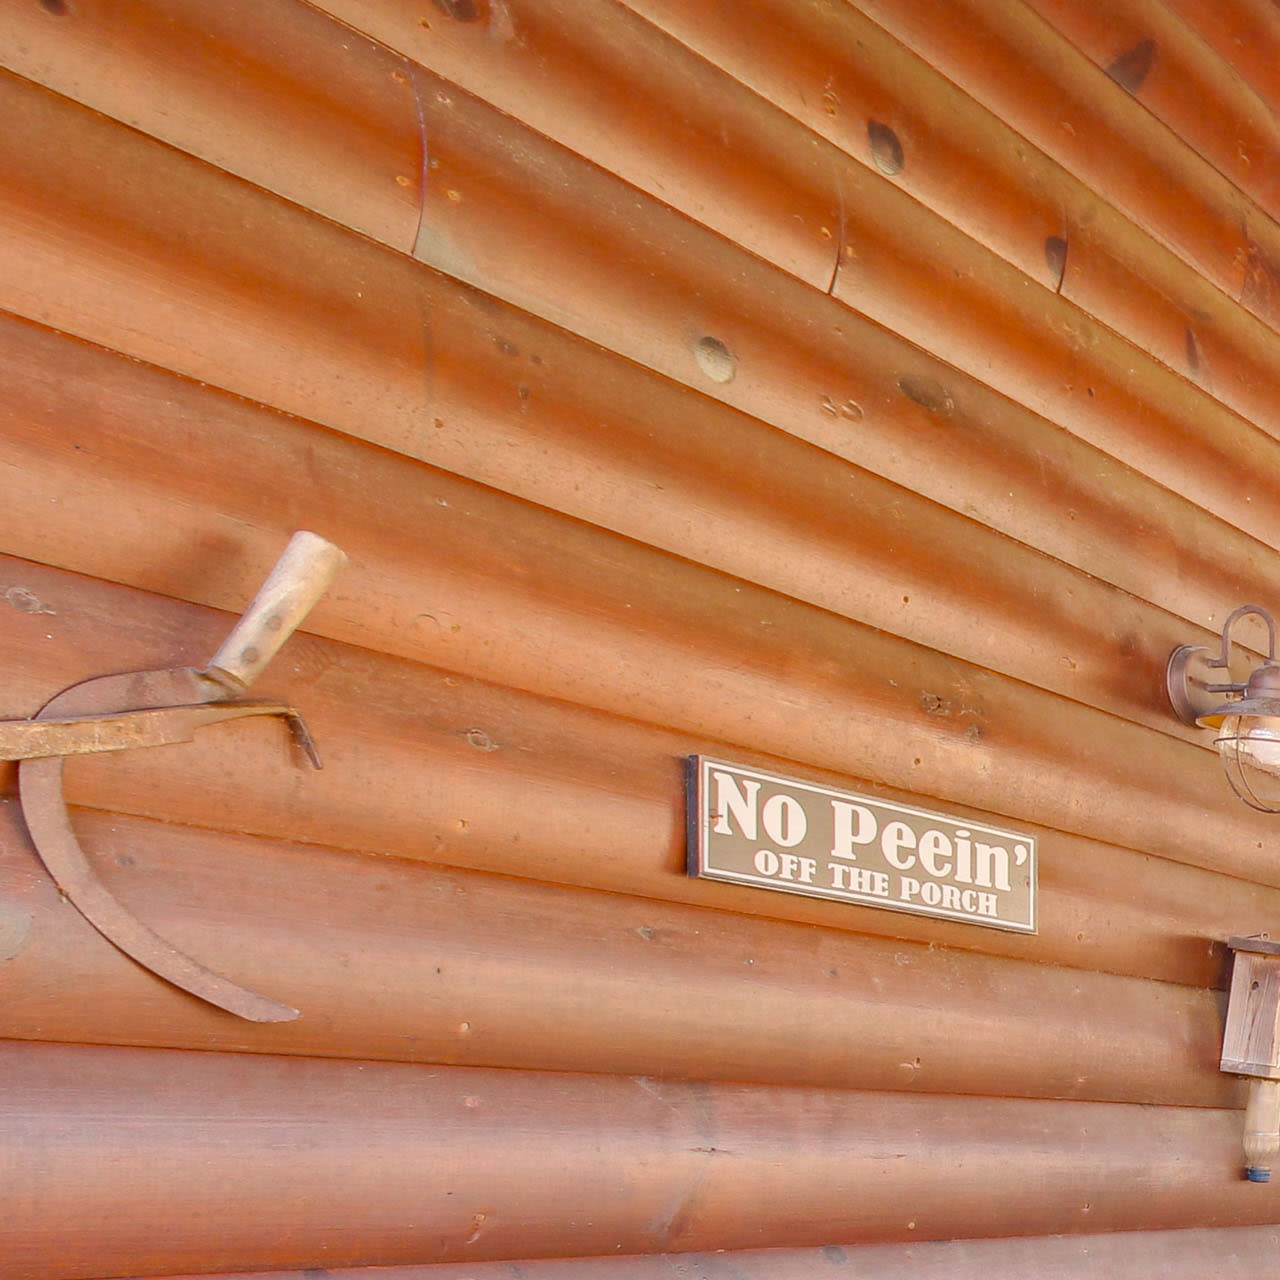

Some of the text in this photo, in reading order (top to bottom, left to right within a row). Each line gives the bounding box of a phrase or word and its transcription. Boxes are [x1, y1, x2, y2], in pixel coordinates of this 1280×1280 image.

[754, 850, 998, 917] OFF THE PORCH
[831, 799, 1027, 891] Peein'
